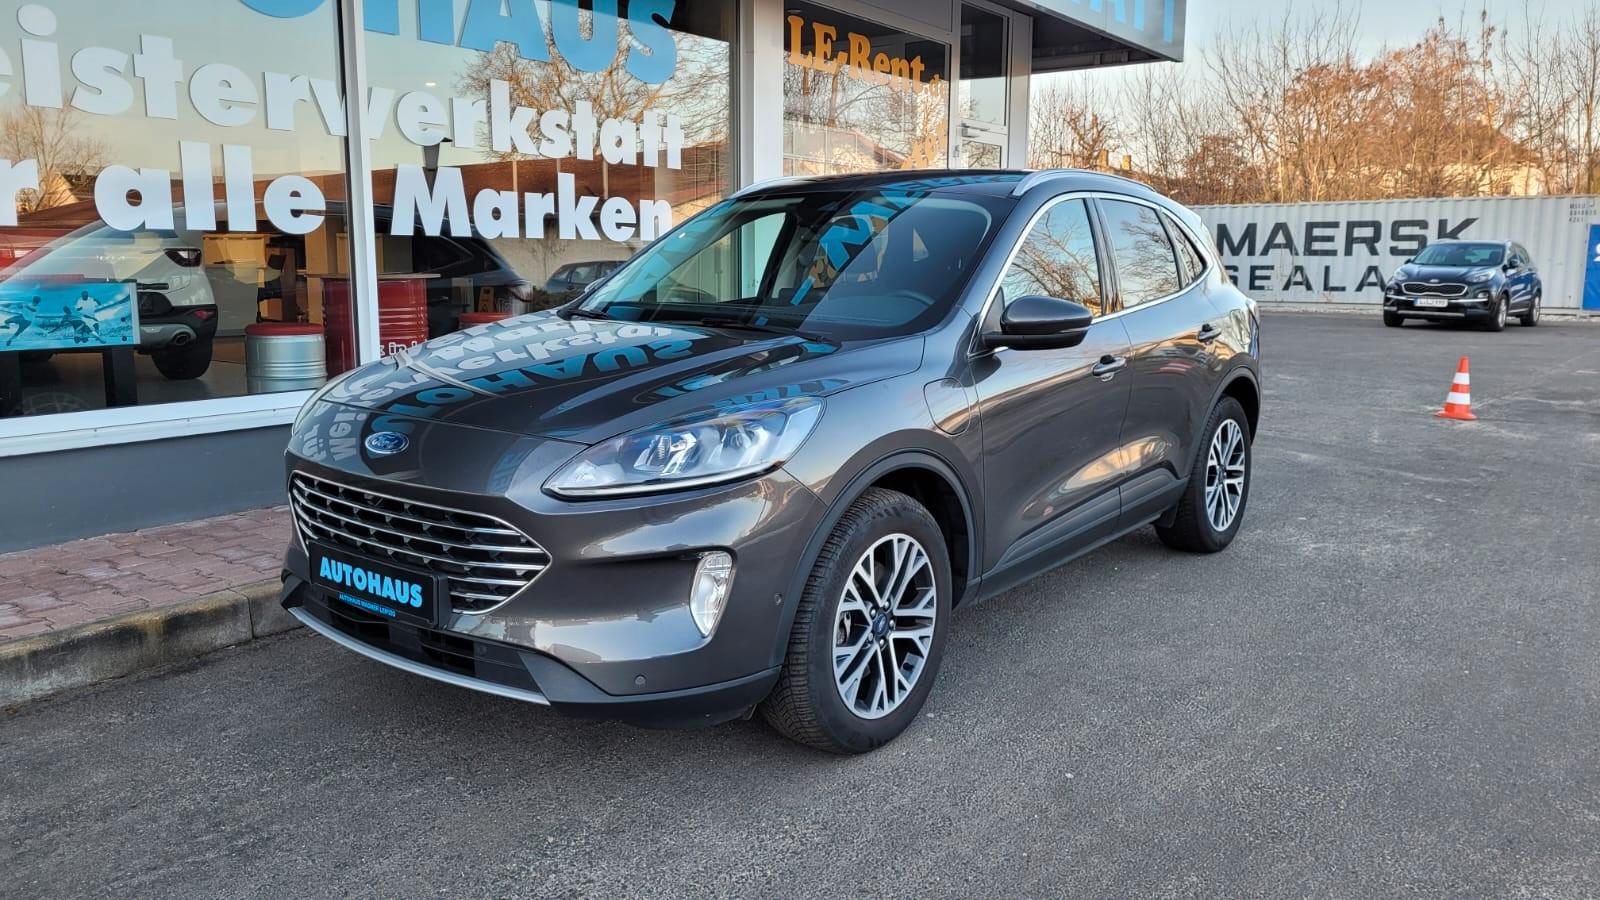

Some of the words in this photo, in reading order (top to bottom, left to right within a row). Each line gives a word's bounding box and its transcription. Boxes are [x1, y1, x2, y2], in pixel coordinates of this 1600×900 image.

[0, 4, 684, 169] isterwerkstatt
[94, 140, 326, 235] alle
[391, 163, 673, 241] Marken
[1216, 217, 1480, 257] MAERSK
[320, 556, 422, 608] AUTOHAUS
